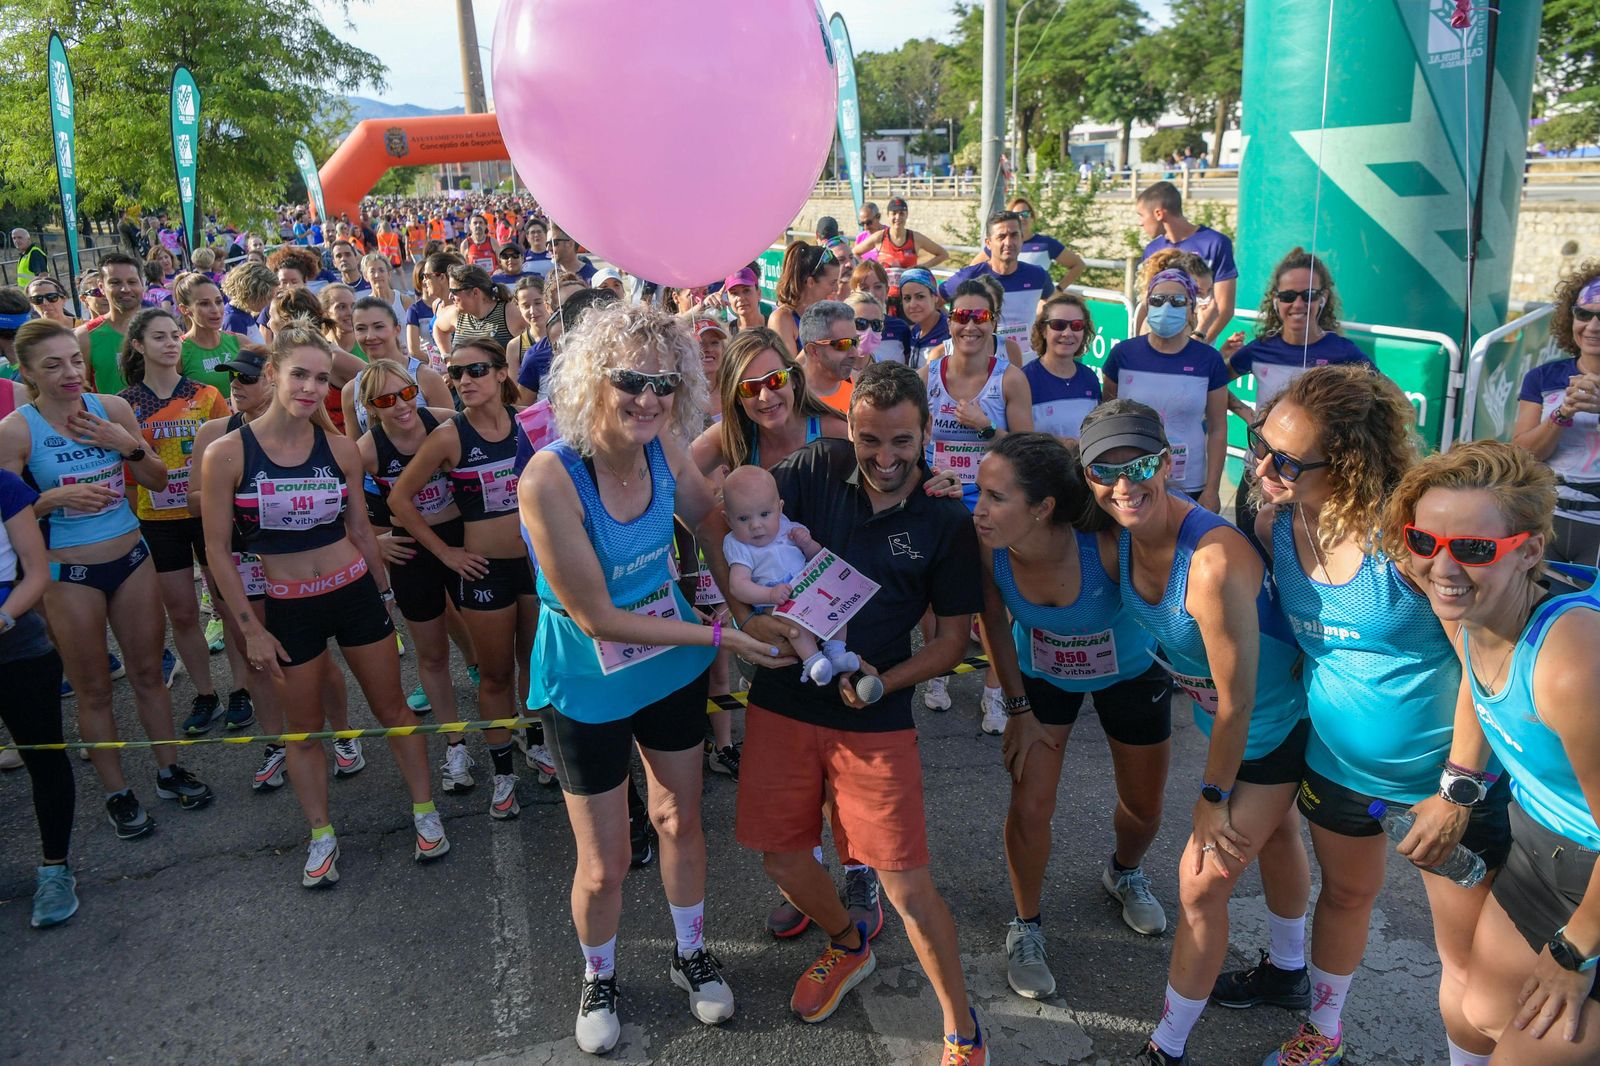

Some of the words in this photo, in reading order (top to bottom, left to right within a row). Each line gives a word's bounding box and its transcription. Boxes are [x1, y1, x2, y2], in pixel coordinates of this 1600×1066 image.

[950, 456, 971, 468] 698
[275, 482, 337, 493] COVIRAN
[418, 485, 440, 501] 591
[290, 495, 314, 511] 141
[300, 571, 347, 594] NIKE
[789, 554, 836, 599] COVIRAN
[817, 588, 833, 601] 1
[838, 592, 862, 614] vithas
[1303, 619, 1361, 640] olimpo
[1043, 634, 1110, 648] COVIRAN
[1055, 650, 1088, 664] 850
[1064, 668, 1097, 676] vithas
